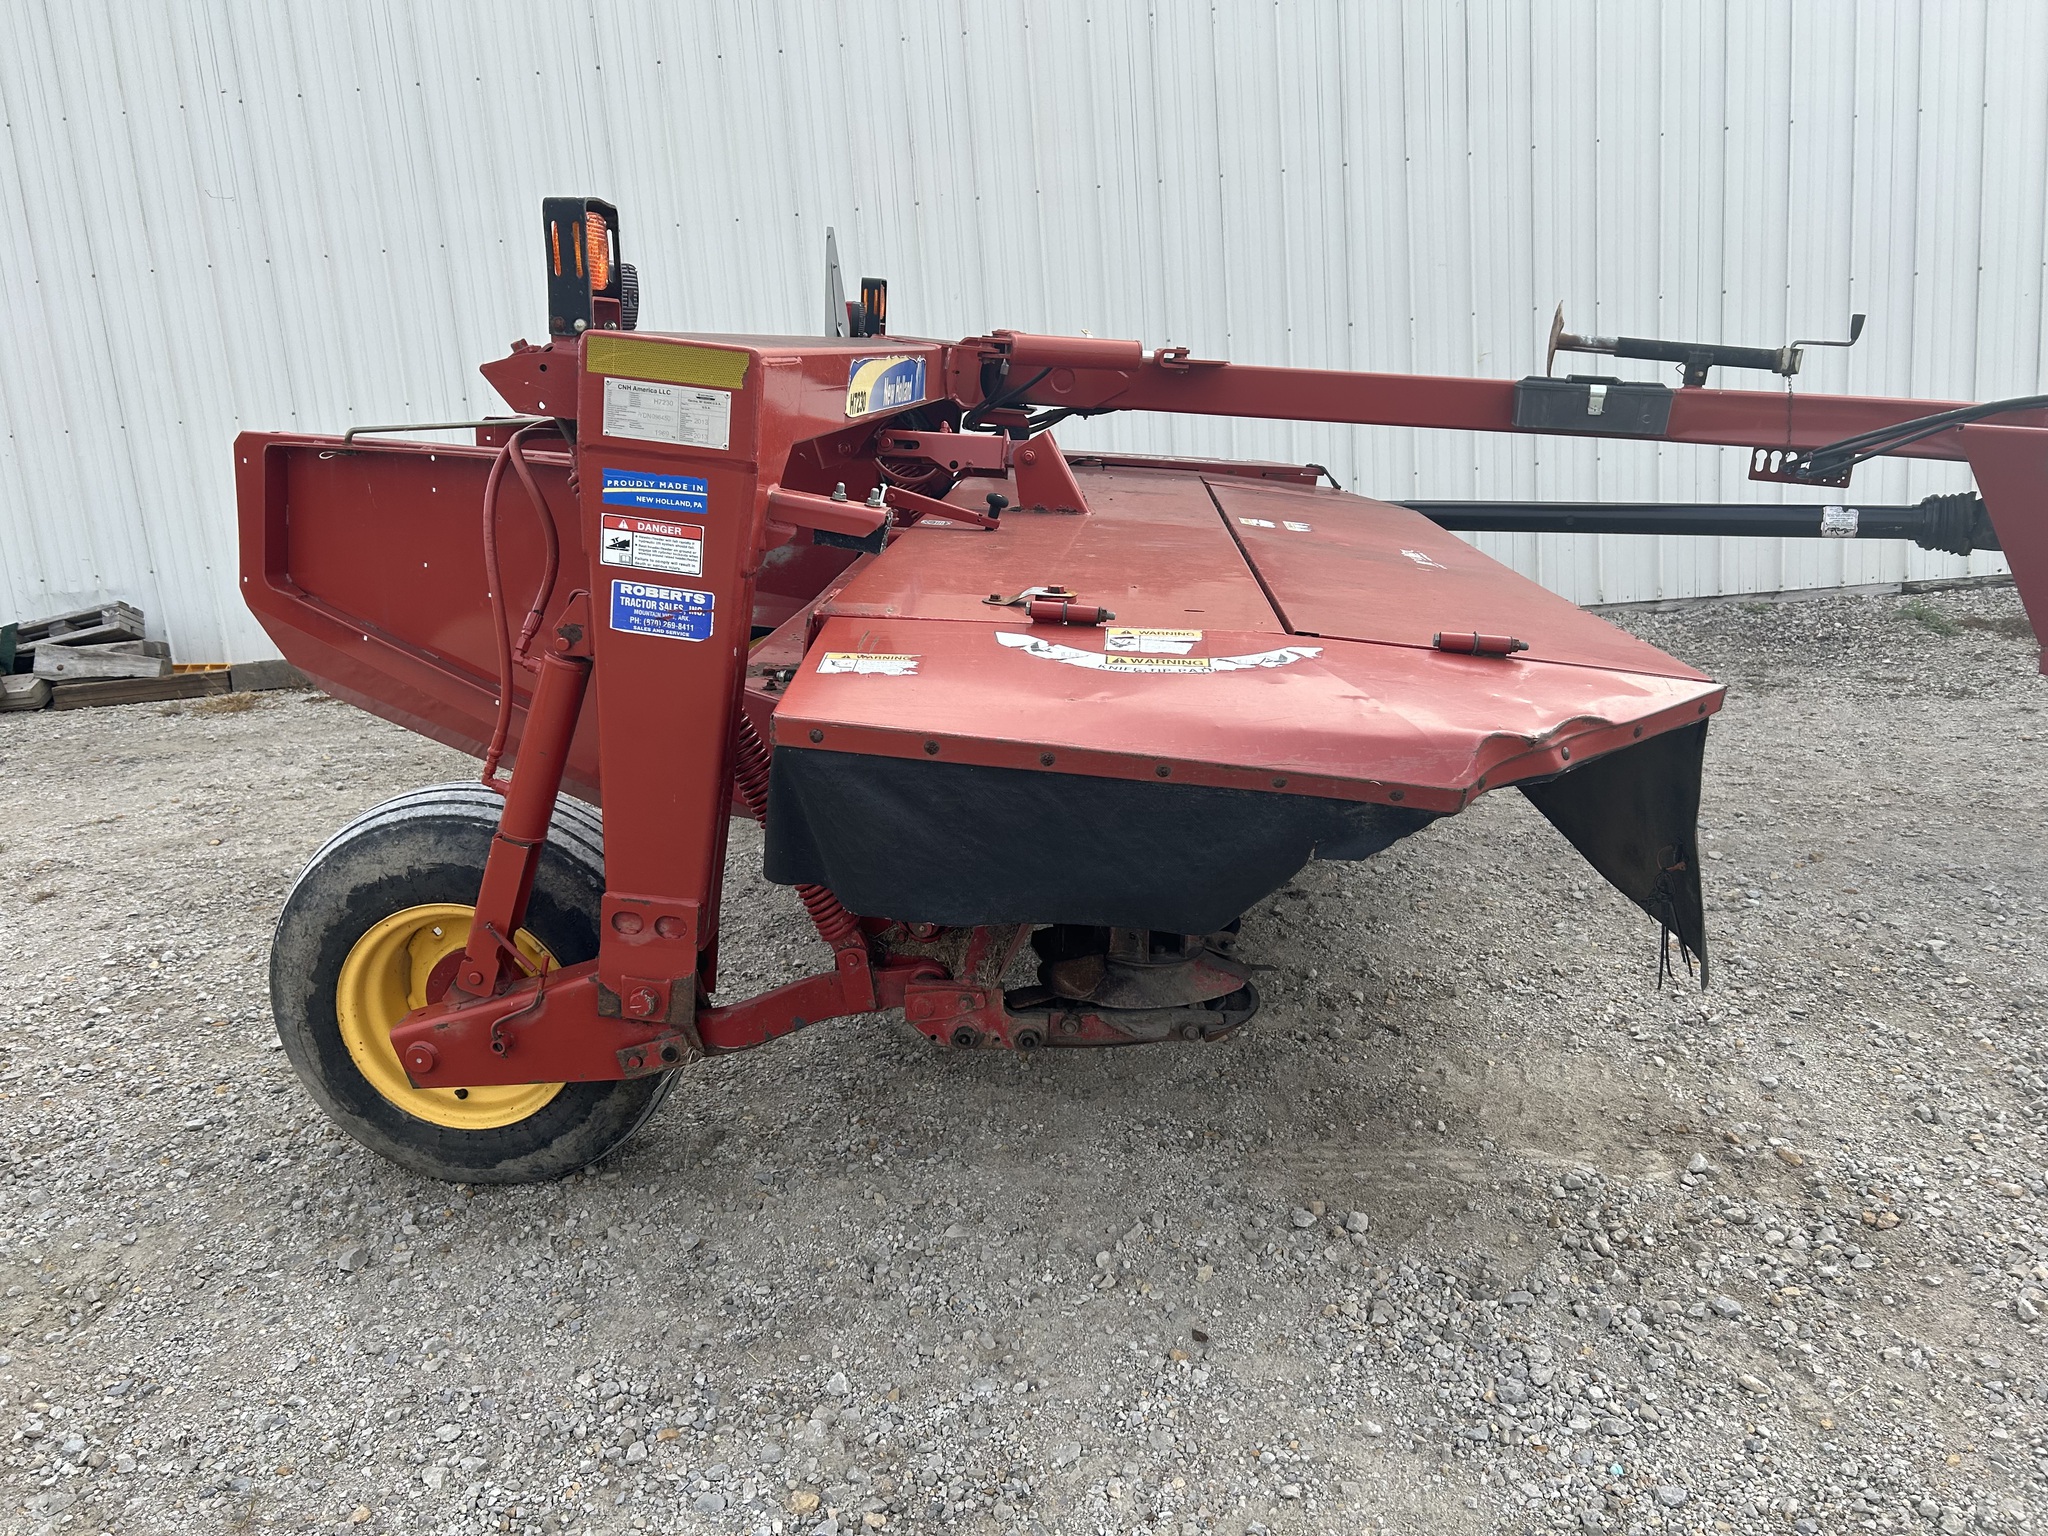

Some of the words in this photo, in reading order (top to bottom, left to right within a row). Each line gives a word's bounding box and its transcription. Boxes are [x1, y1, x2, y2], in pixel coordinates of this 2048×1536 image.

[632, 386, 658, 394] America
[882, 376, 896, 406] New
[850, 390, 866, 415] H7230
[660, 482, 688, 490] MADE
[656, 498, 692, 508] HOLLAND,
[637, 522, 681, 535] DANGER
[620, 584, 706, 604] ROBERTS
[620, 596, 657, 610] TRACTOR
[688, 606, 705, 616] INC.
[634, 609, 662, 617] MOUNTAIN
[630, 616, 642, 625] PH:
[663, 621, 694, 631] 269-8411
